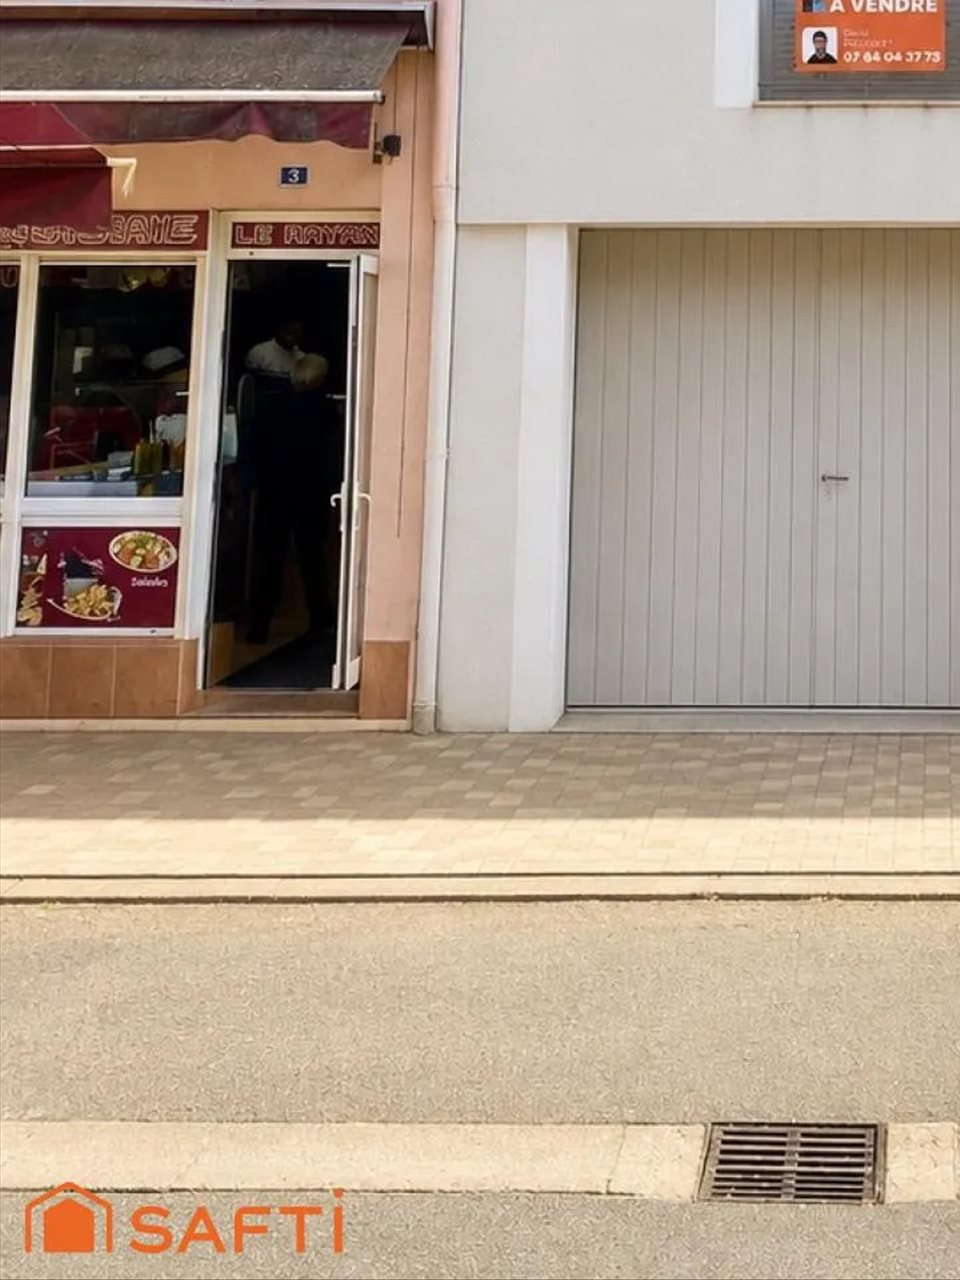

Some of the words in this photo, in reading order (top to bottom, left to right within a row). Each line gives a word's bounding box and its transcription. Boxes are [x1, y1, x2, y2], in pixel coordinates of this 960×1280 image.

[287, 169, 300, 183] 3
[234, 224, 273, 245] LE
[283, 224, 378, 245] RAYAN
